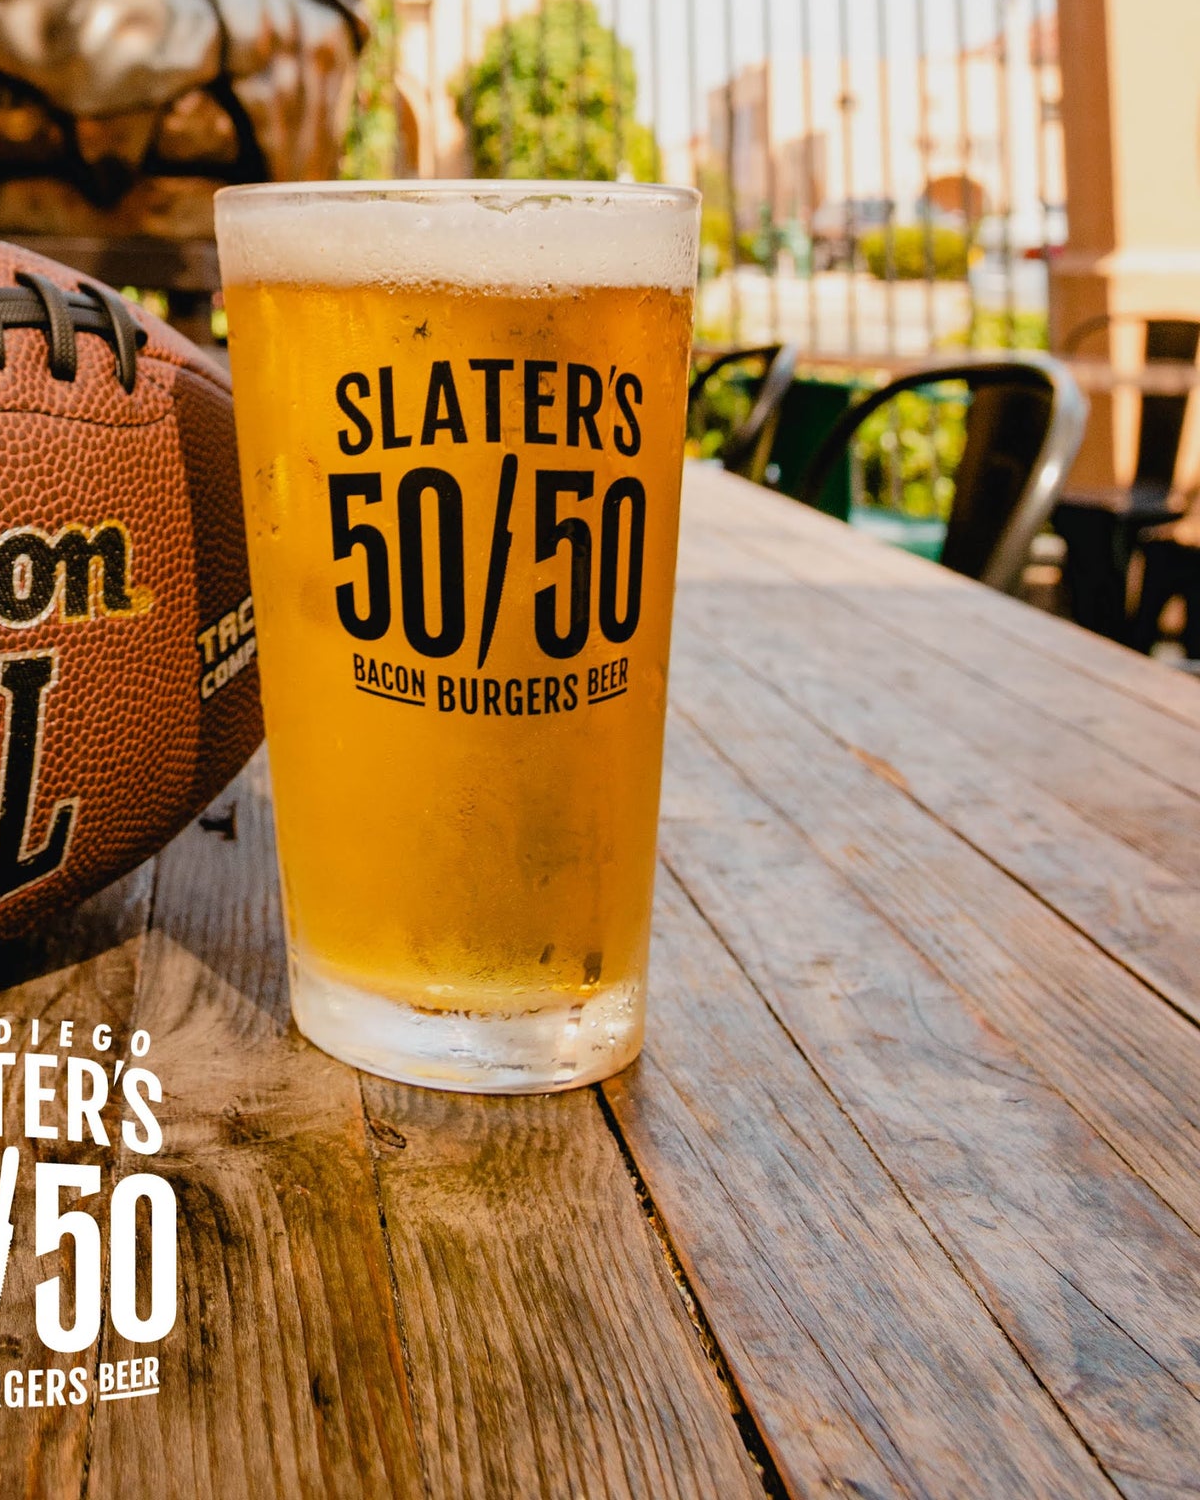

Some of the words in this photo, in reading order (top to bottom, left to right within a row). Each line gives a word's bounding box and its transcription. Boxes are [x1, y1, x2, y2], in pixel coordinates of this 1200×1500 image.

[335, 358, 643, 457] SLATER'S
[328, 453, 646, 670] 50/50
[353, 653, 426, 699] BACON
[437, 673, 579, 717] BURGERS
[587, 657, 629, 696] BEER
